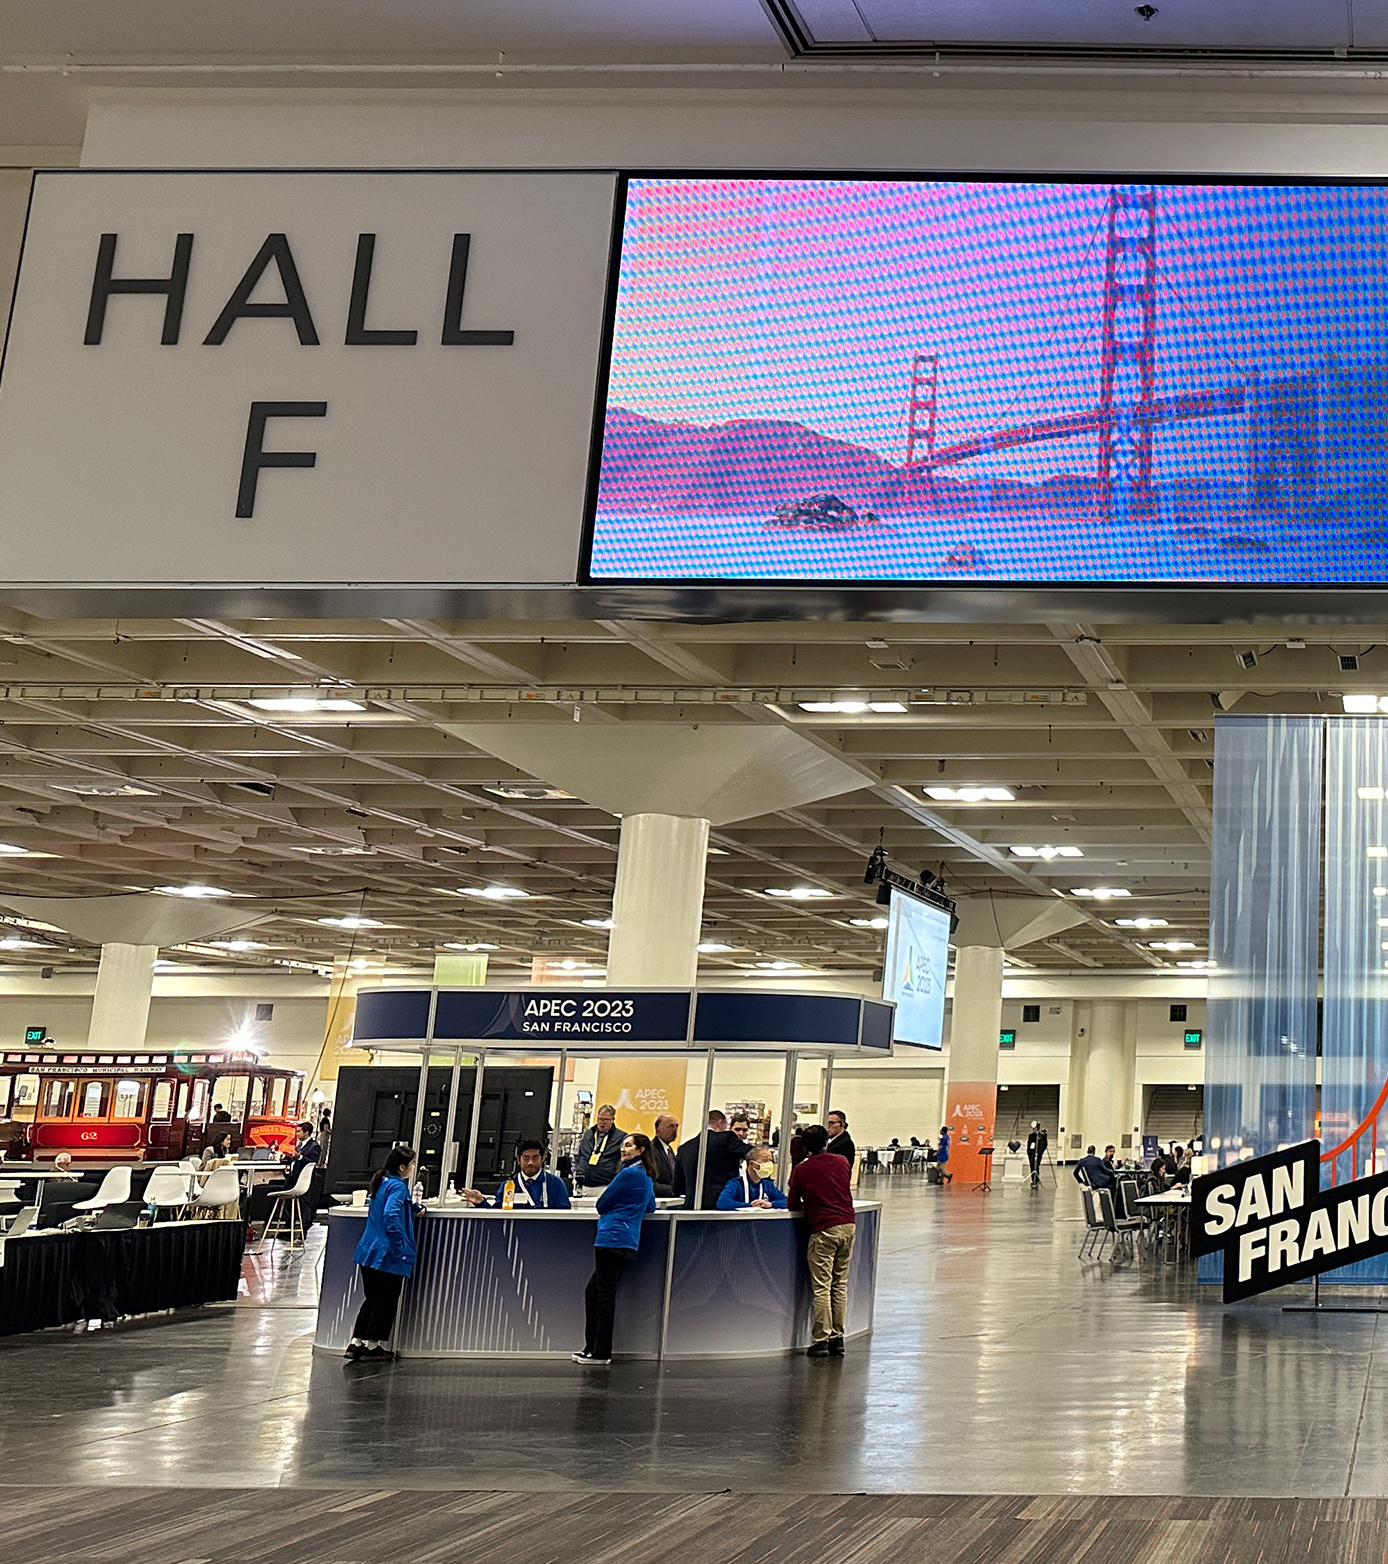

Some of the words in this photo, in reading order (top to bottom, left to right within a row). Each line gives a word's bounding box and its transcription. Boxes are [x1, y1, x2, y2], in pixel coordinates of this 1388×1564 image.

[83, 232, 515, 346] HALL
[234, 401, 328, 519] F
[524, 999, 577, 1017] APEC
[581, 999, 634, 1017] 2023
[522, 1022, 550, 1032] SAN
[554, 1022, 632, 1033] FRANCISCO
[27, 1031, 42, 1040] EXIT
[1000, 1034, 1013, 1042] EXIT
[1185, 1034, 1200, 1042] EXIT
[635, 1088, 666, 1099] APEC
[640, 1100, 669, 1110] 2023
[81, 1132, 98, 1140] 62
[1204, 1160, 1305, 1236] SAN
